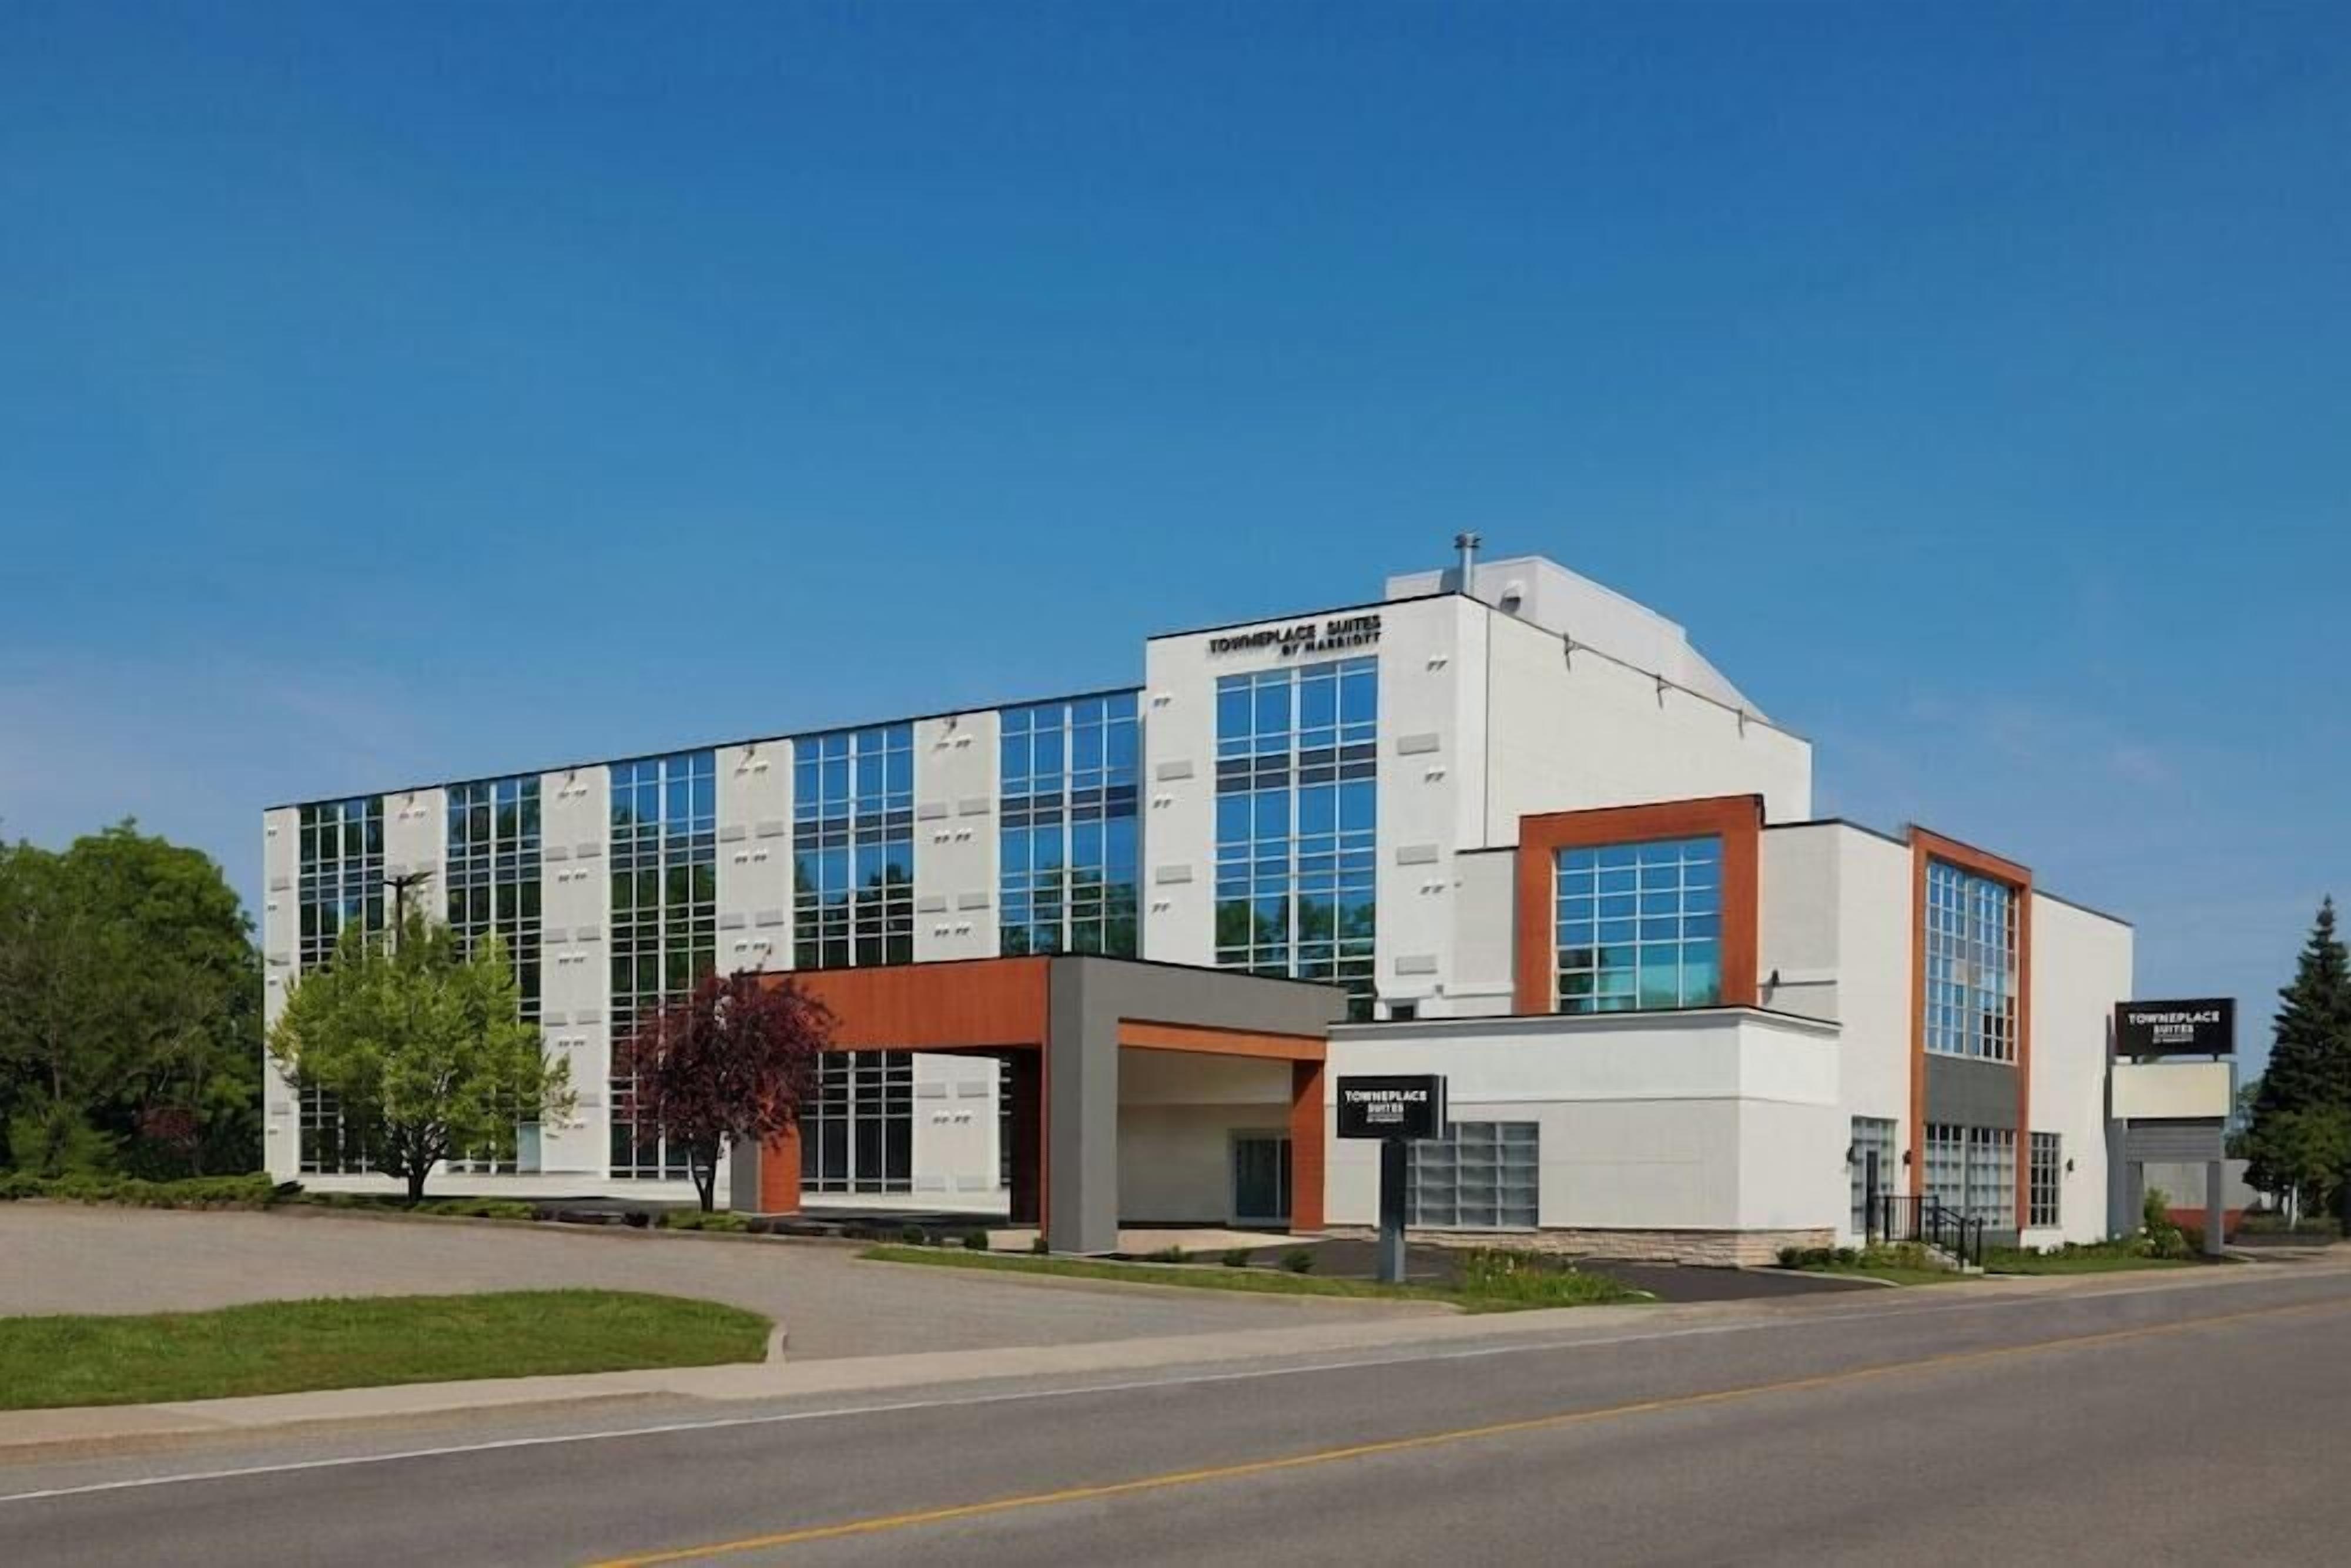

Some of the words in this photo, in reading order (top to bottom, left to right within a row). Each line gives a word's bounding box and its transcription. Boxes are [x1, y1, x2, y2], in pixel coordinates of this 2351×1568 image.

[1209, 624, 1316, 653] TOWNEPLACE
[2128, 1010, 2220, 1025] TOWNEPLACE
[1345, 1090, 1427, 1103] TOWNEPLACE
